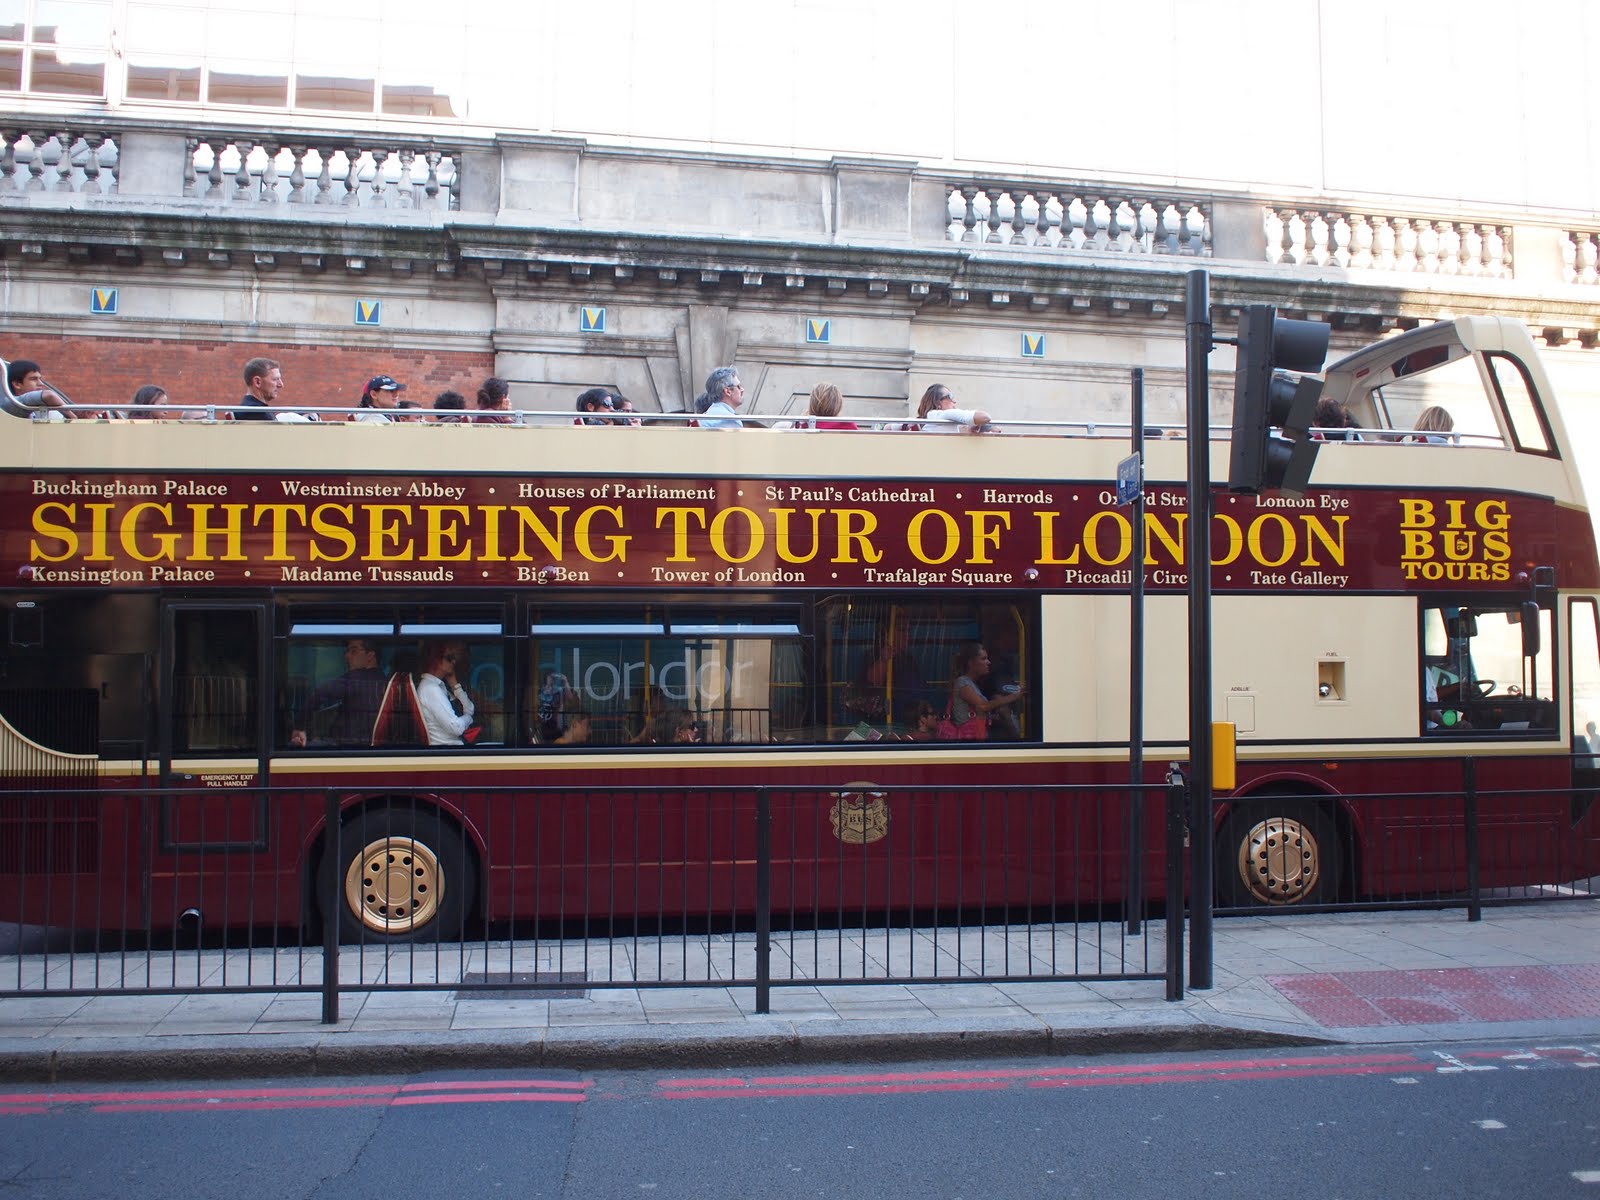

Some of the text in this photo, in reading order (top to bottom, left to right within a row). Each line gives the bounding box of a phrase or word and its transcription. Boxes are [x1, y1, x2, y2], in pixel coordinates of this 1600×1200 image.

[32, 479, 1349, 511] Buckingham Palace Westminster Abbey Houses of Parliament St Paul's Cathedral Harrods Oxd Str London Eye
[1399, 498, 1512, 530] BIG
[30, 501, 1350, 567] SIGHTSEEING TOUR OF LONDON
[1400, 530, 1512, 562] BUS
[31, 566, 1349, 588] Kensington Palace Madame Tussauds Big Ben Tower of London Trafalgar Square Piccadil Circ Tate Gallery
[1401, 561, 1511, 582] TOURS
